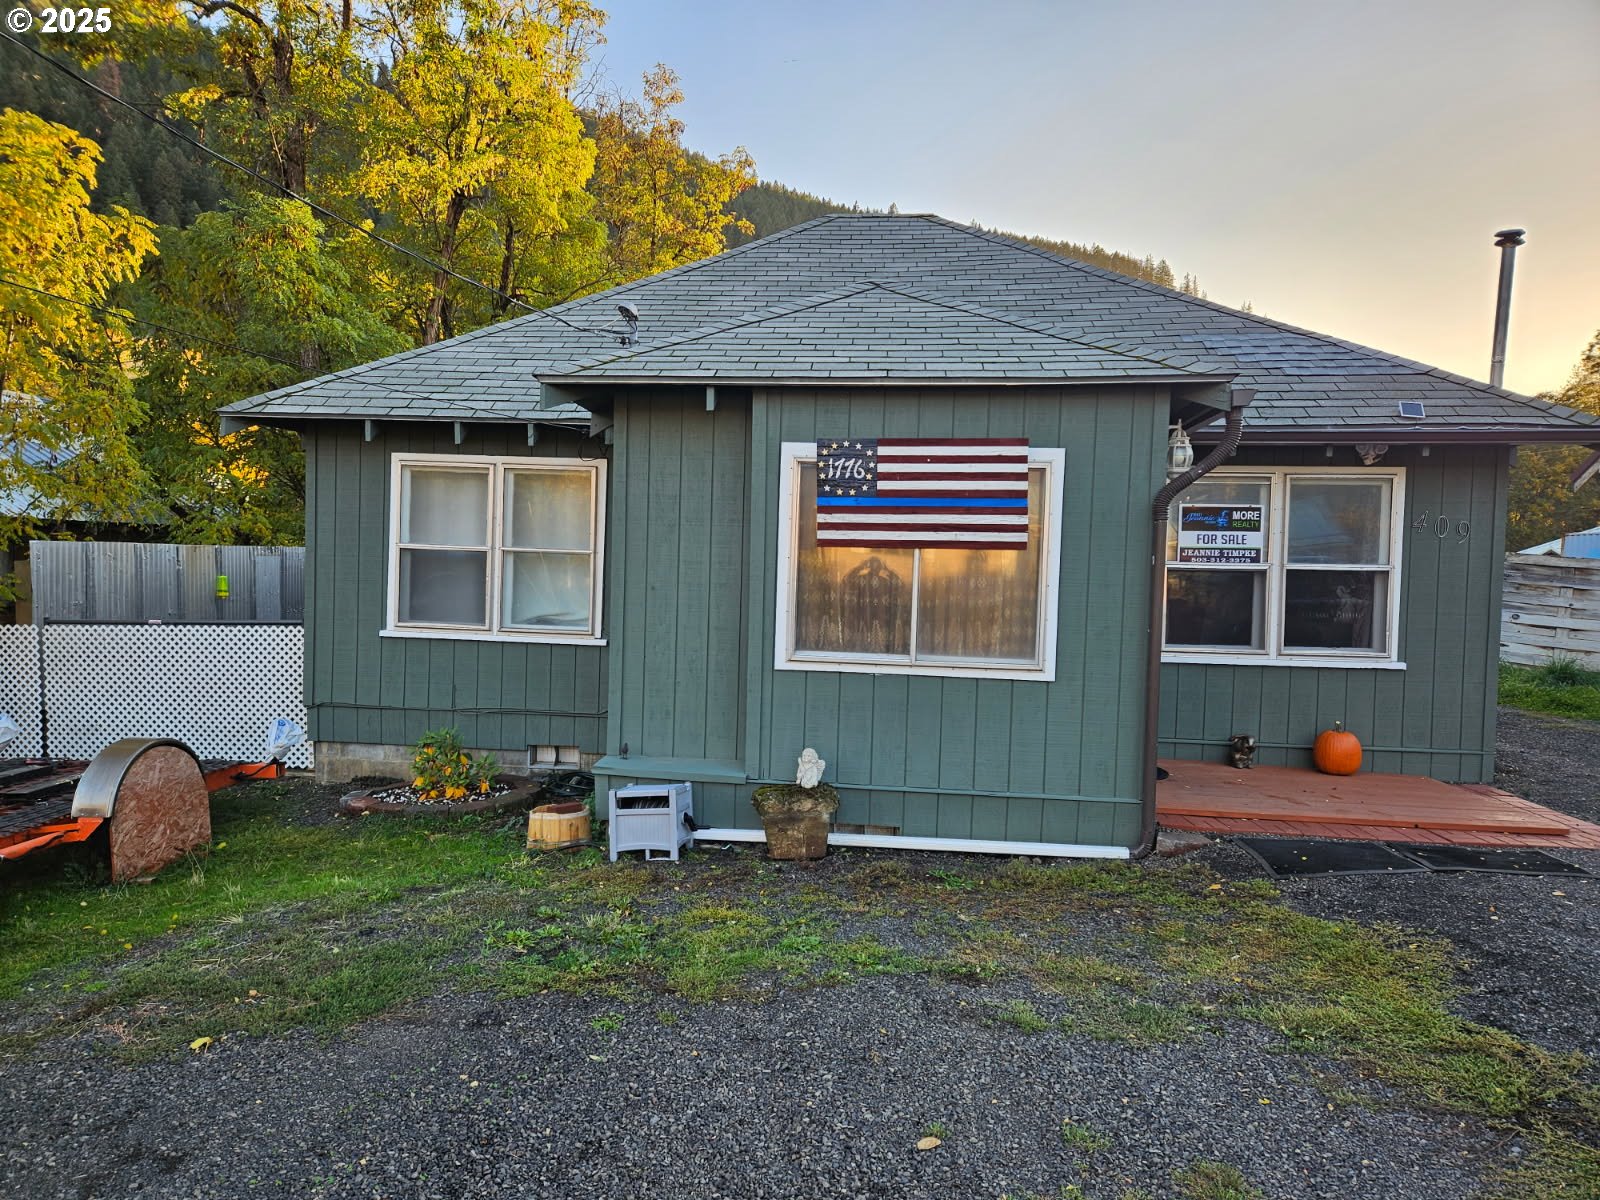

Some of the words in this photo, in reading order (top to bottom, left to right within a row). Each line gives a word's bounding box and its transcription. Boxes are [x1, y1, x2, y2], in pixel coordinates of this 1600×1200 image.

[828, 457, 866, 479] 1776
[1232, 511, 1260, 520] MORE
[1232, 520, 1259, 528] REALTY
[1411, 510, 1470, 544] 409
[1196, 533, 1218, 545] FOR
[1221, 534, 1248, 545] SALE
[1182, 549, 1221, 557] JEANNIE
